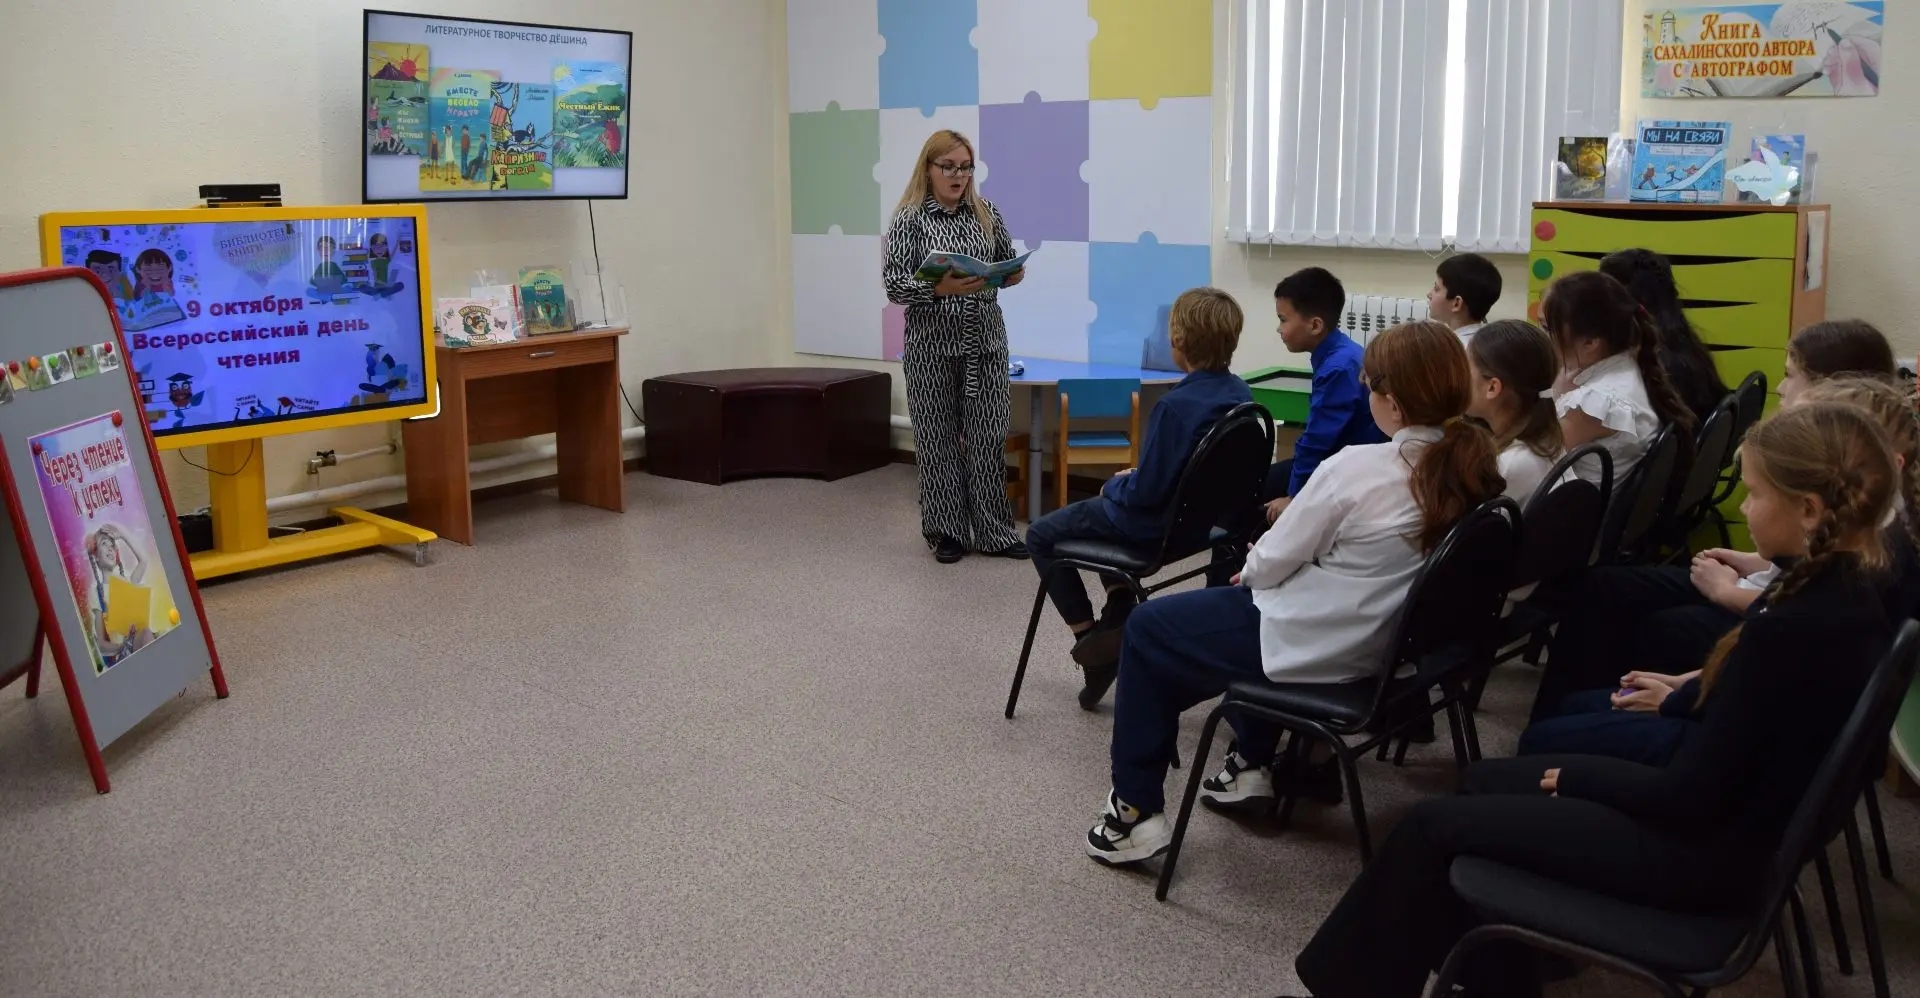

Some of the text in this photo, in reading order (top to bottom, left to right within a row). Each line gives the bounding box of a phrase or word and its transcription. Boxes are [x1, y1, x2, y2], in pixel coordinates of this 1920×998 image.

[425, 24, 588, 46] ЛИТЕРАТУРНОЕ ТВОРЧЕСТВО ДЁШИНА
[1653, 39, 1817, 61] САХАЛИНСКОГО АВТОРА
[1673, 59, 1794, 79] С АВТОГРАФОМ
[1645, 130, 1721, 143] МЫ НА СВЯЗИ
[491, 149, 547, 165] КАПРИЗНАЯ
[186, 300, 201, 318] 9
[209, 295, 304, 317] октября
[132, 317, 370, 351] Всероссийский день
[217, 349, 301, 370] чтения
[40, 436, 125, 488] Через чтение
[81, 475, 123, 519] успеху
